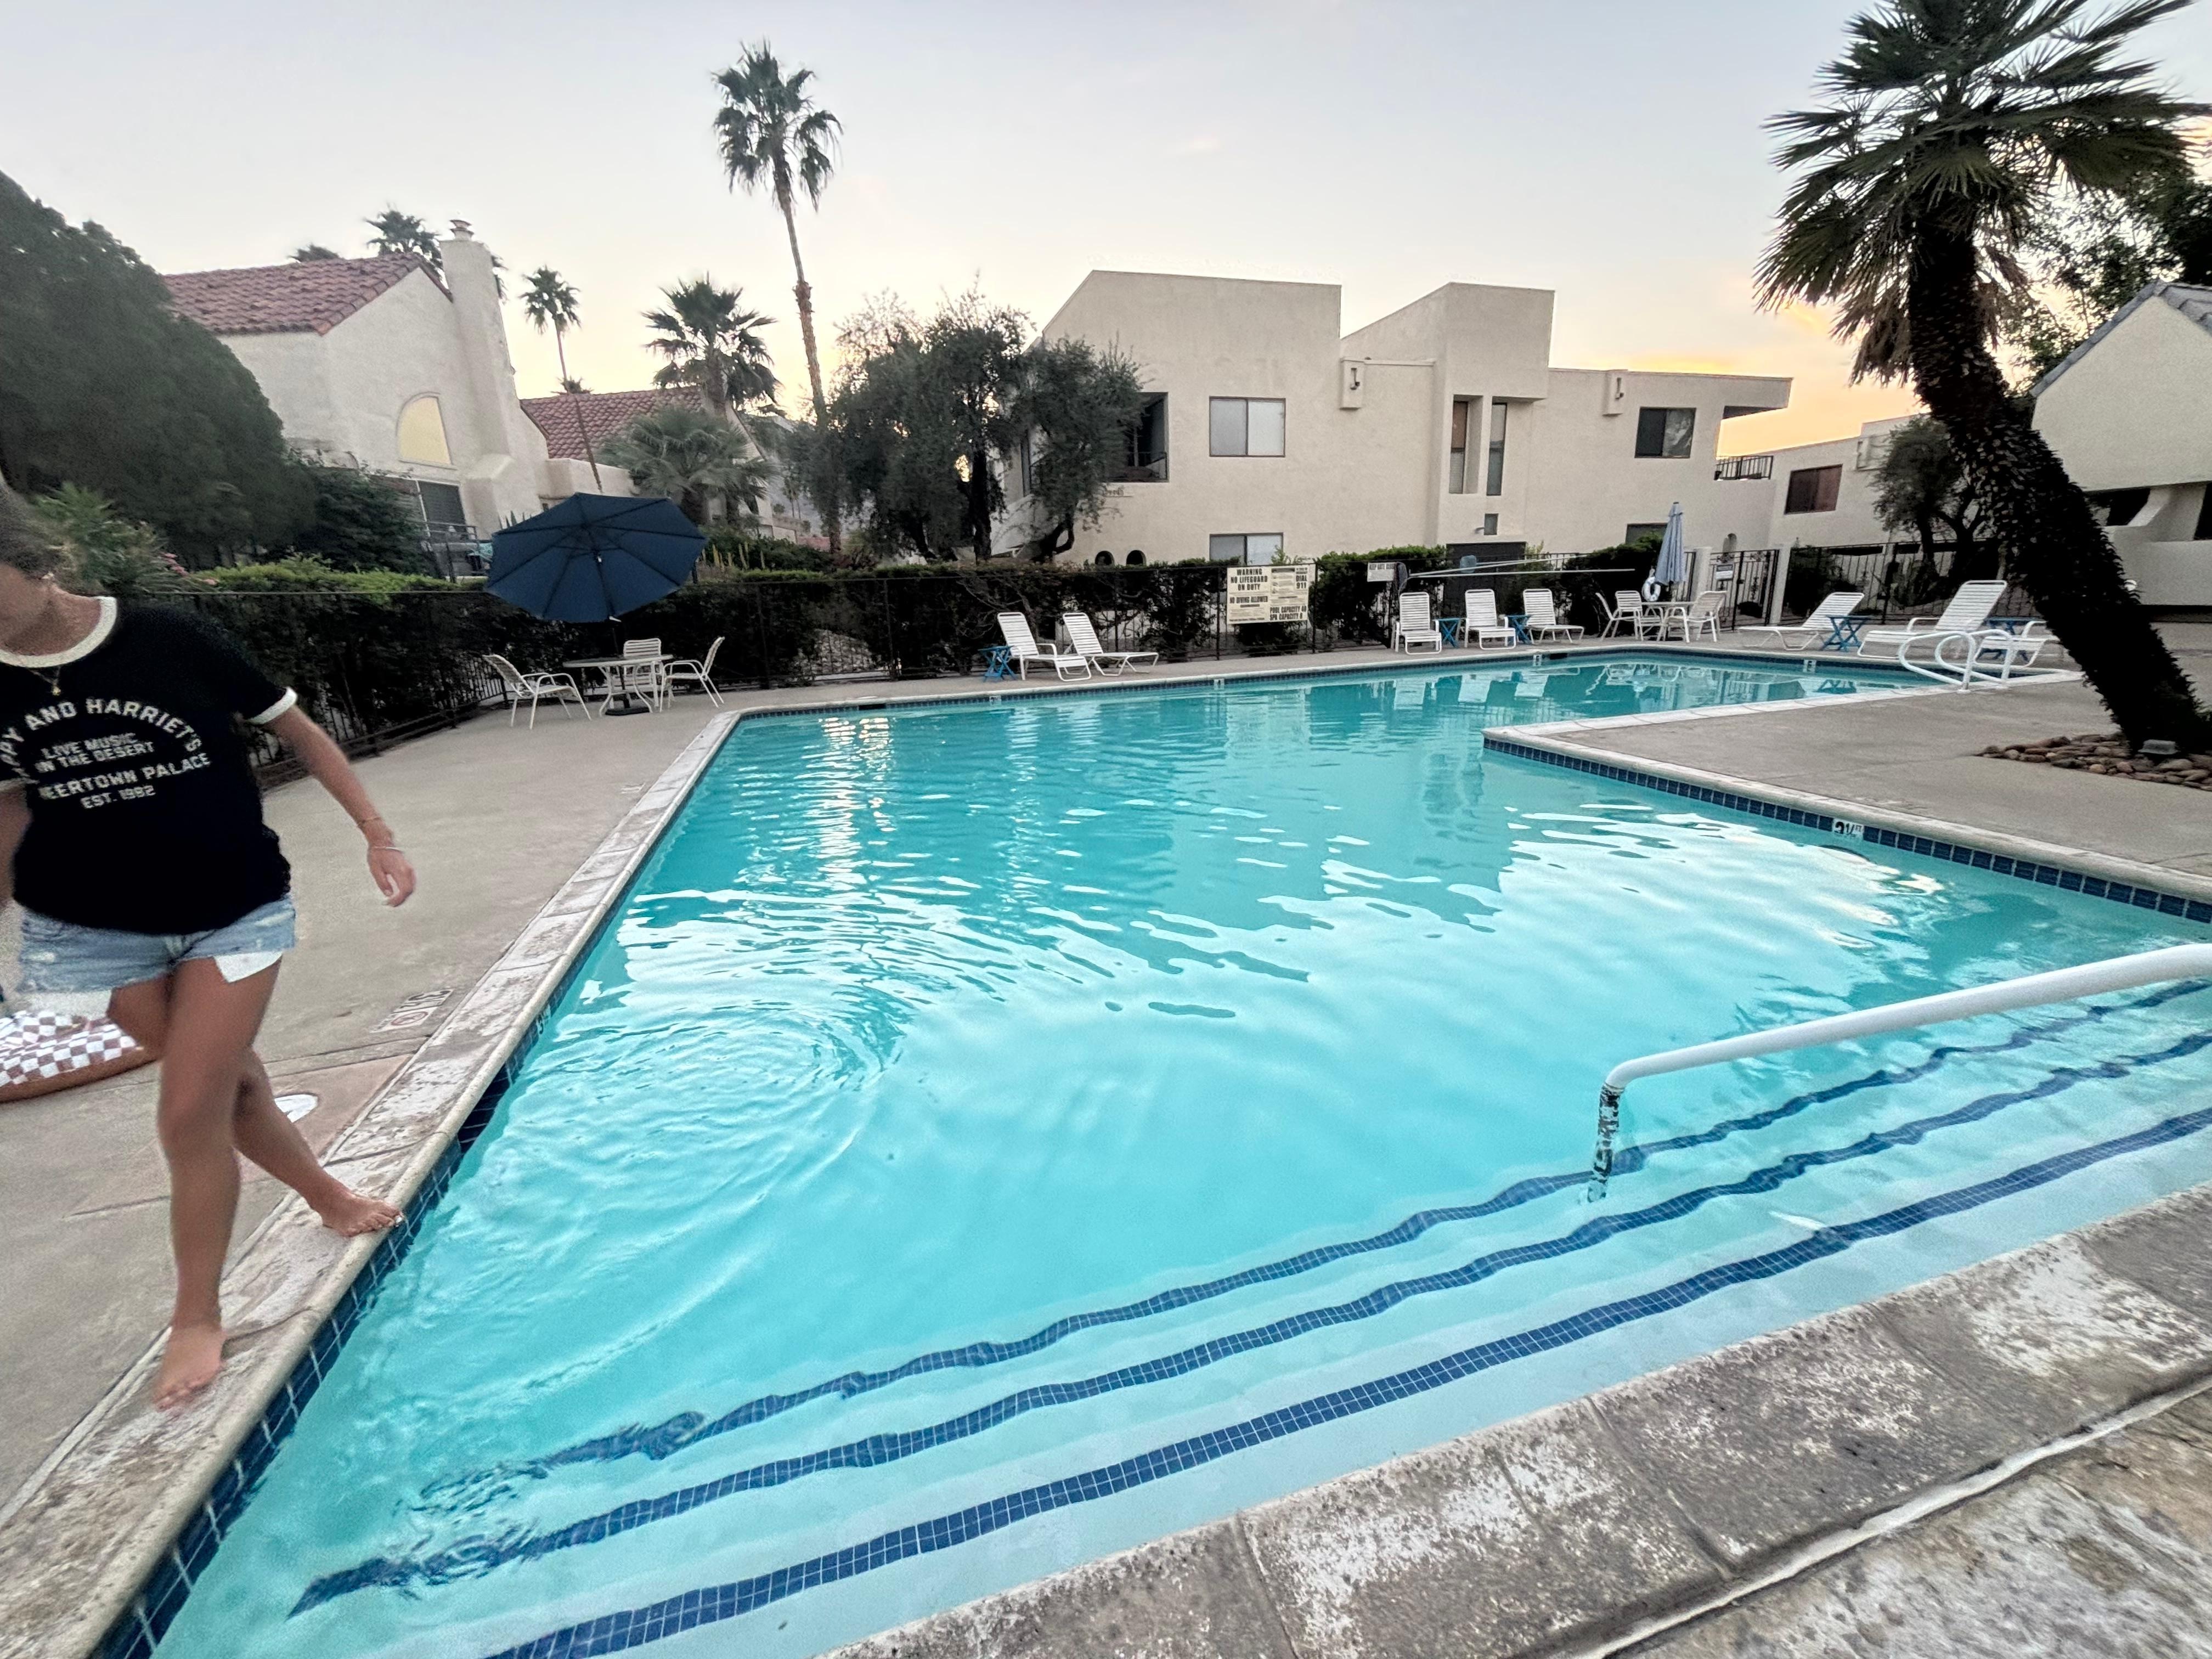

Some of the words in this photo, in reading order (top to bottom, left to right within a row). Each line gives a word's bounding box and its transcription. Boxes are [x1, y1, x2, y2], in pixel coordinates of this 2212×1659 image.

[24, 701, 78, 731] AND
[85, 698, 202, 752] HARRIET'S
[34, 760, 57, 774] IN
[57, 753, 93, 768] THE
[92, 741, 155, 762] DESERT
[41, 741, 82, 760] LIVE
[84, 732, 138, 751] MUSIC
[142, 753, 212, 780] PALACE
[80, 792, 118, 809] EST.
